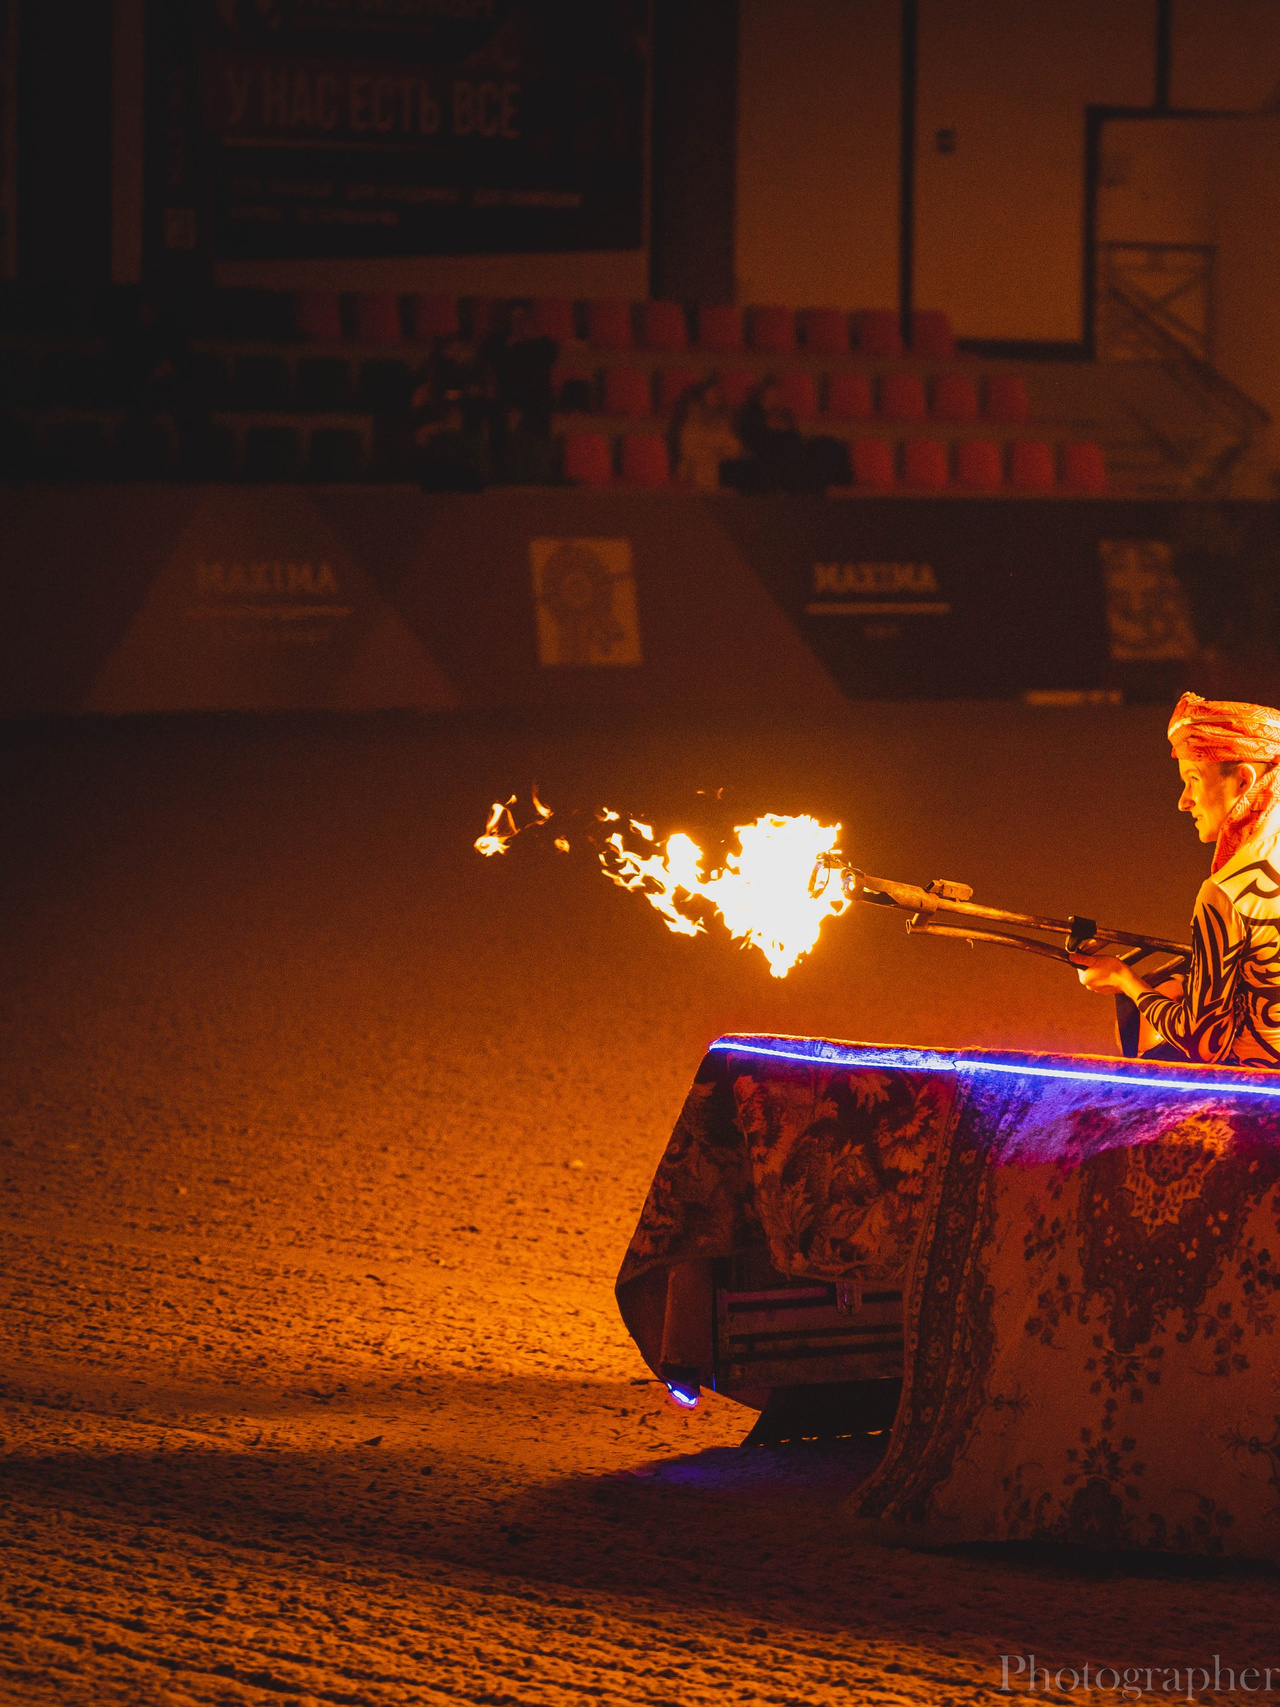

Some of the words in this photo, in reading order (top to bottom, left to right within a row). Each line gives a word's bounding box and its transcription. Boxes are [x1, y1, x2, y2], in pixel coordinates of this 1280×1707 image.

[226, 69, 251, 126] У
[261, 69, 339, 130] НАС
[348, 75, 442, 134] ЕСТЬ
[451, 81, 522, 140] ВСЕ
[196, 560, 340, 594] MAXIMA
[812, 562, 939, 593] MAXIMA
